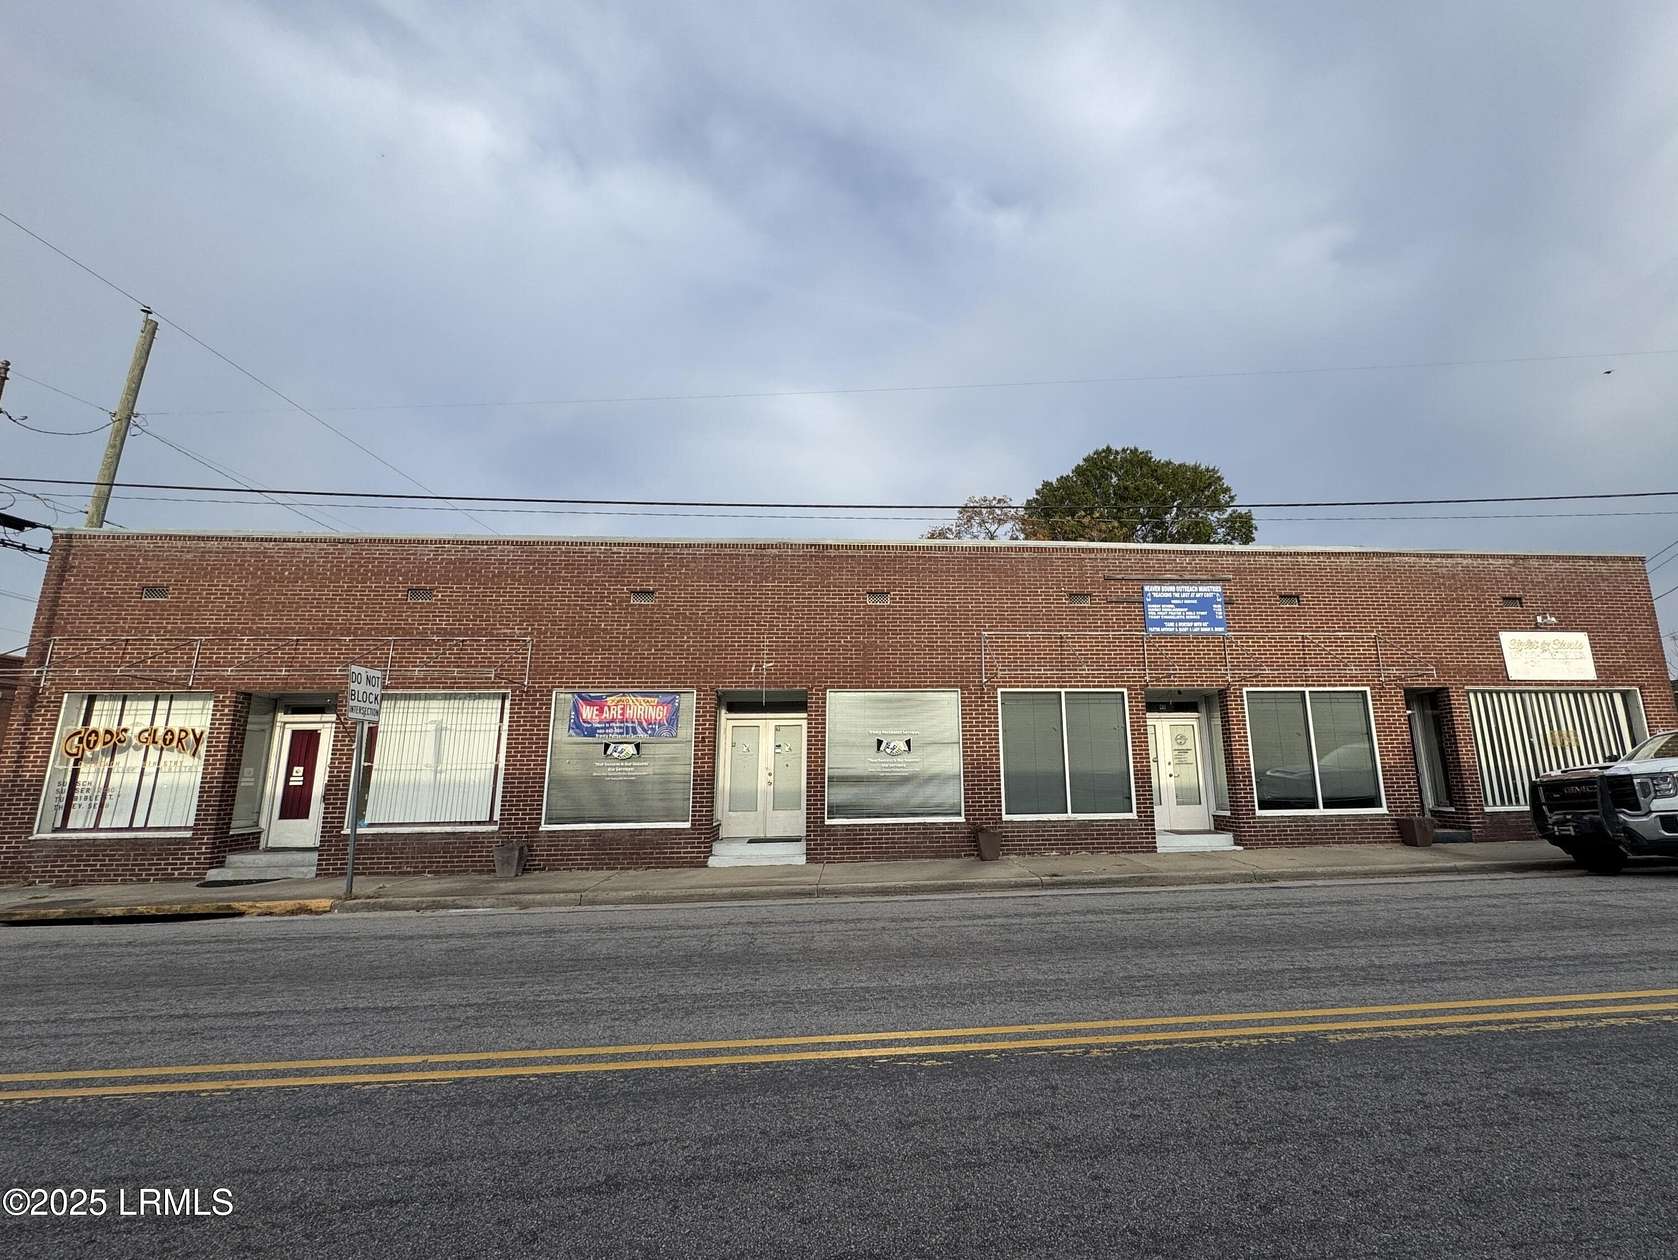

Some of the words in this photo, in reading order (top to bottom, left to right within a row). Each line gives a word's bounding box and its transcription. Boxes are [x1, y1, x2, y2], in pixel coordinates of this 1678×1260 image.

[351, 671, 362, 685] DO
[365, 674, 380, 688] NOT
[350, 689, 379, 705] BLOCK
[349, 705, 378, 717] INTERSECTION
[582, 704, 600, 720] WE
[601, 704, 623, 720] ARE
[625, 704, 667, 722] HIRING!
[137, 728, 204, 758] GLORY
